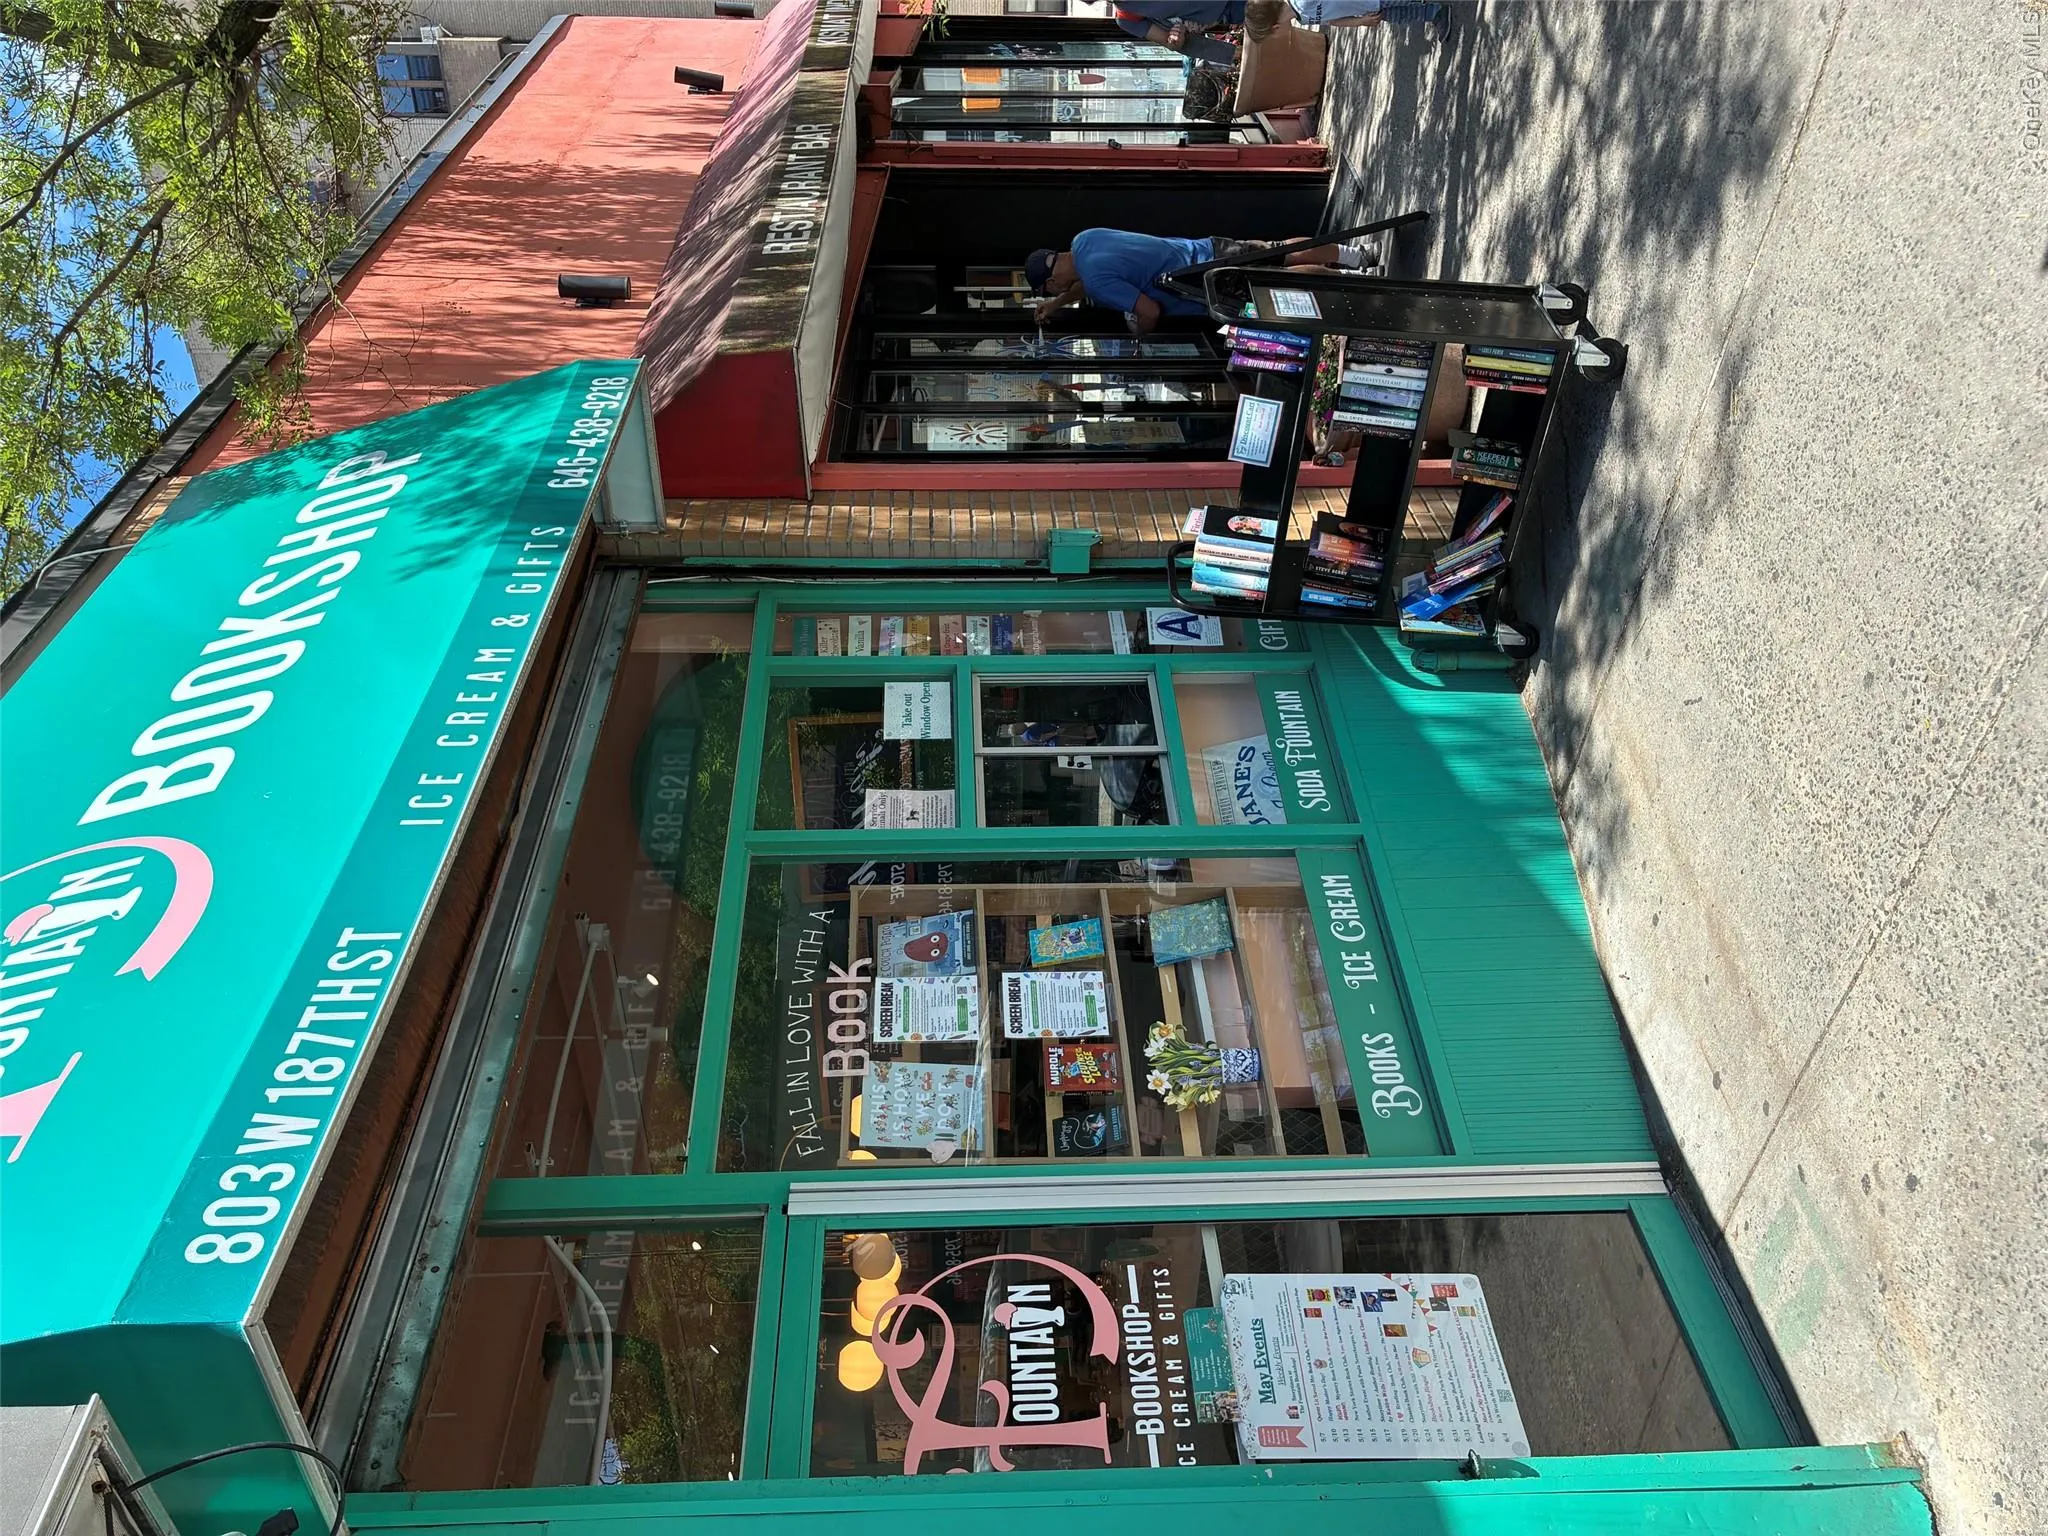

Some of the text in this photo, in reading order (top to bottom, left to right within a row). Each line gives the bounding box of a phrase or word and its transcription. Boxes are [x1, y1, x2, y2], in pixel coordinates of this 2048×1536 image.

[815, 14, 853, 46] KISMAT
[762, 123, 833, 254] RESTAURANT BAR
[547, 375, 631, 489] 646-438-9218
[1239, 402, 1255, 446] Discount Cart
[76, 449, 422, 826] BOOKSHOP
[855, 630, 865, 653] Vanilla
[1157, 615, 1201, 640] A
[400, 525, 566, 827] ICE CREAM & GIFTS
[902, 707, 912, 728] Take
[903, 693, 912, 706] out
[921, 682, 933, 739] Window Open
[1274, 690, 1331, 812] SODA FOUNTAIN
[869, 803, 878, 827] Service
[1320, 874, 1367, 943] CREAM
[1340, 950, 1379, 990] ICE
[822, 957, 873, 1078] BOOK
[879, 982, 893, 1038] SCREEN BREAK
[1008, 977, 1024, 1034] SCREEN BREAK
[786, 907, 836, 1158] FALL IN LOVE WITH A
[1049, 1047, 1060, 1085] MURDLE
[1076, 1052, 1096, 1084] SLEUTHS
[1084, 1051, 1101, 1077] LOOSE
[1361, 1032, 1422, 1120] BOOKS
[870, 1084, 888, 1124] THIS
[893, 1072, 908, 1115] HOW
[915, 1091, 931, 1119] WE
[235, 1111, 321, 1155] W
[183, 1162, 298, 1266] 803
[1122, 1304, 1165, 1435] BOOKSHOP
[1153, 1267, 1197, 1466] CE CREAM & GIFTS
[1250, 1317, 1274, 1404] May Events
[1274, 1359, 1285, 1386] Weekly
[1331, 1428, 1339, 1442] 5/10
[1401, 1428, 1409, 1443] 5/19
